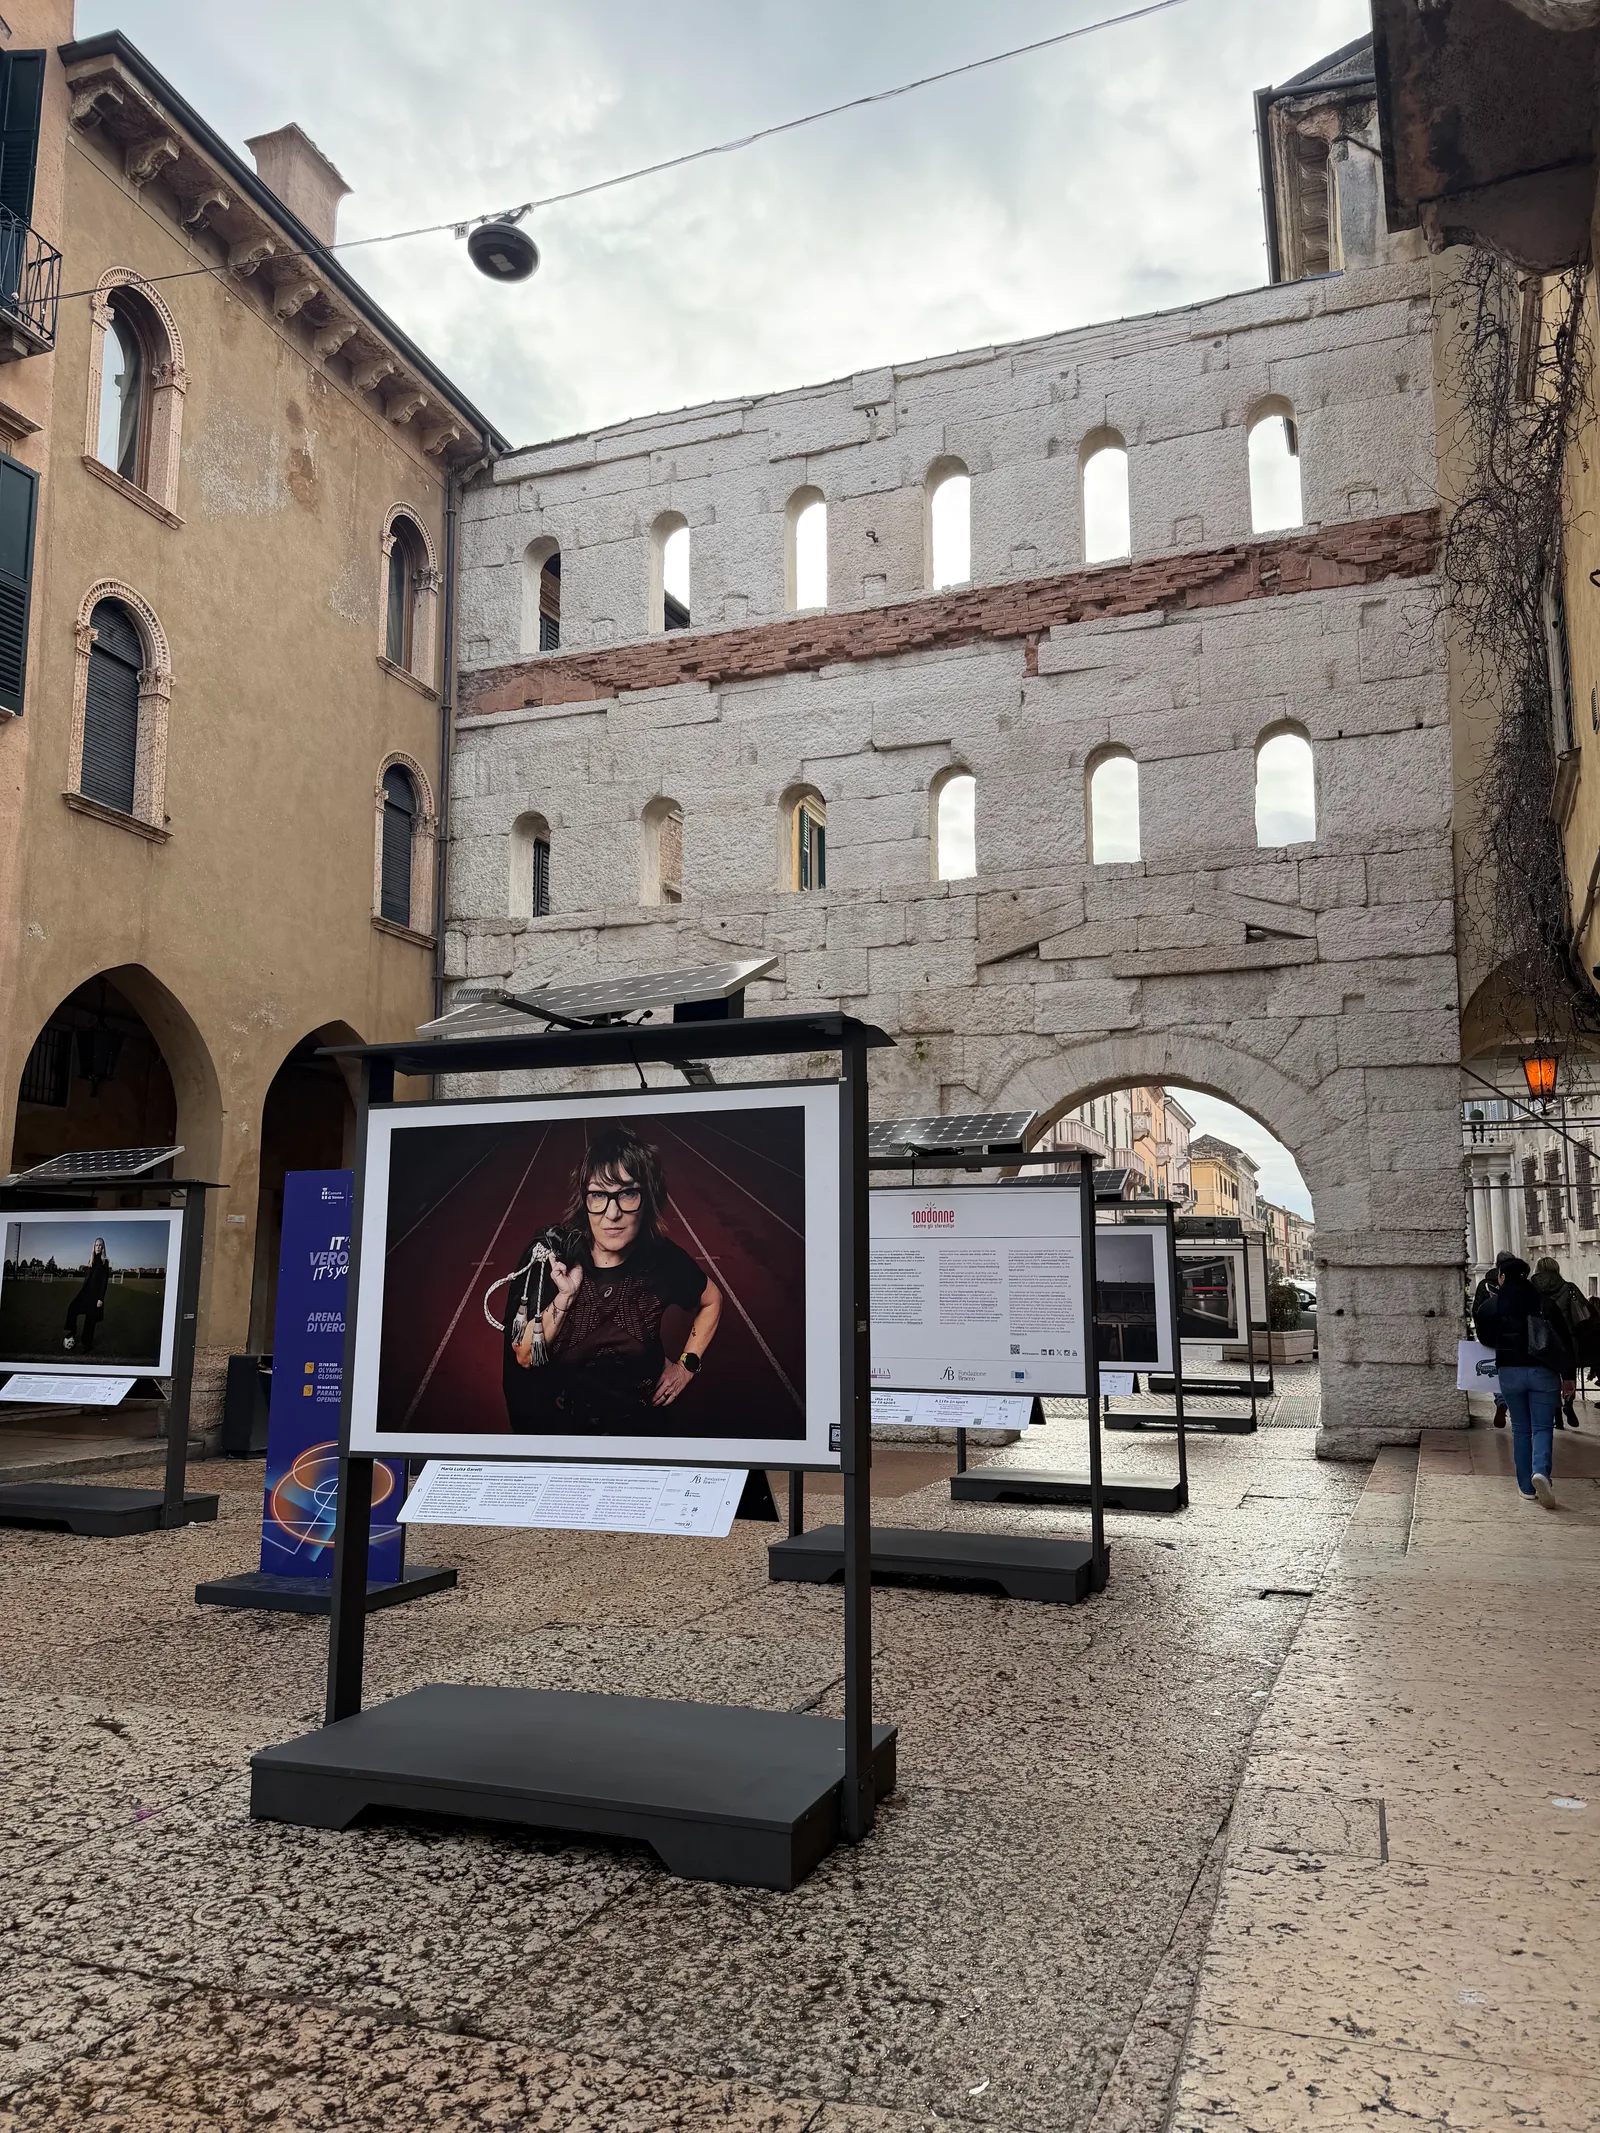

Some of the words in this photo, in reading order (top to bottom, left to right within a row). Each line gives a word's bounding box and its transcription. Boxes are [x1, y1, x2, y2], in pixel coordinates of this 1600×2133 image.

[911, 1207, 954, 1223] 100donne
[329, 1236, 350, 1250] IT'
[309, 1252, 349, 1266] VERO
[333, 1265, 349, 1280] yo
[307, 1312, 342, 1322] ARENA
[306, 1322, 318, 1332] DI
[319, 1322, 346, 1332] VERO
